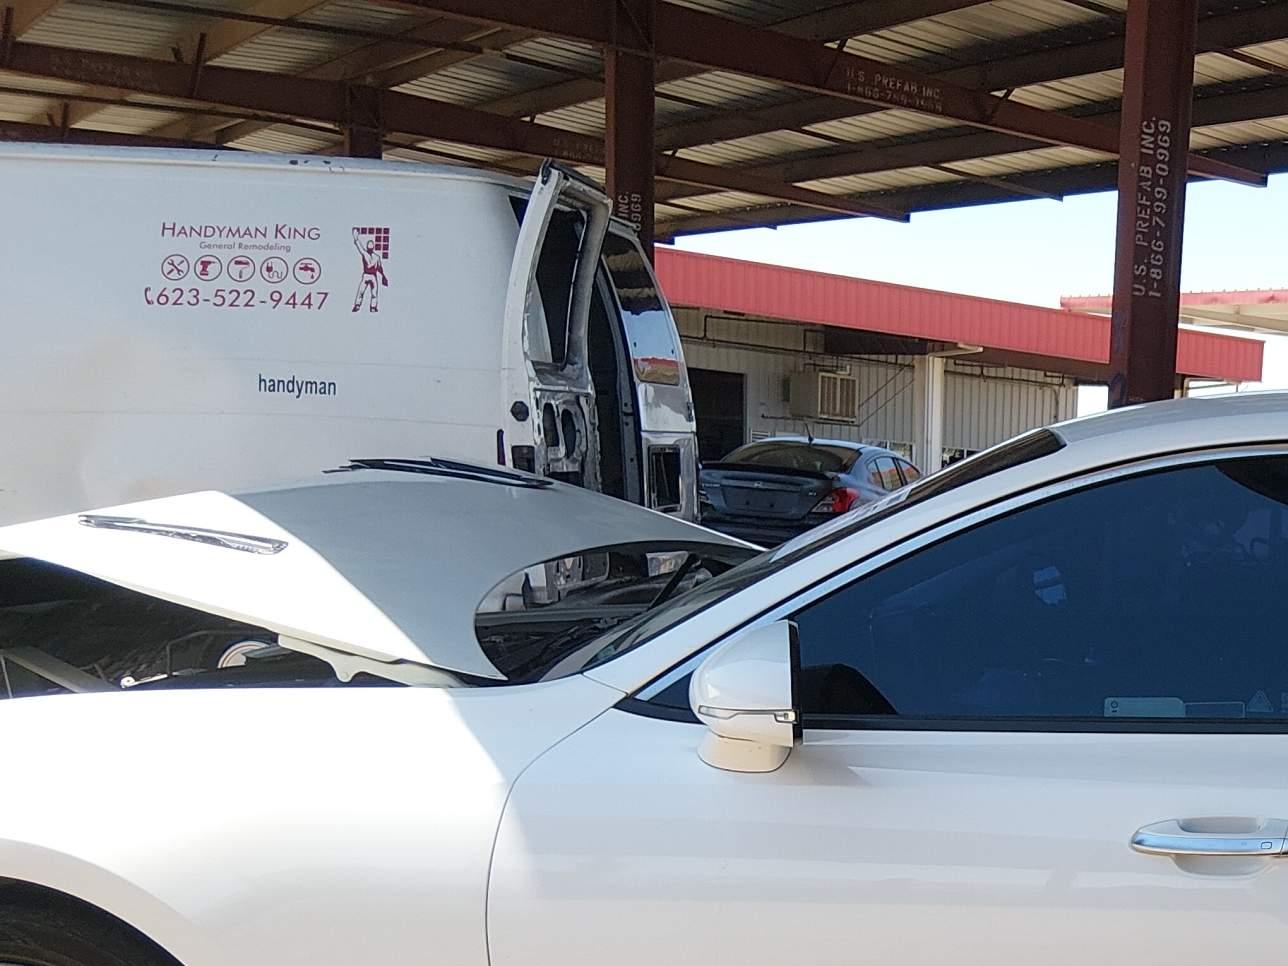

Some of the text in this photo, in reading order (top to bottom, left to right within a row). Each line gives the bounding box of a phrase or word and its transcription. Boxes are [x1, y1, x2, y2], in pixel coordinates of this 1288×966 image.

[1132, 116, 1157, 297] U.S. PREFAB INC.
[1148, 120, 1172, 297] 1-866-799-0969
[161, 222, 321, 241] HANDYMAN KING
[199, 241, 291, 253] General Remodeling
[156, 287, 329, 310] 623-522-9447
[258, 373, 337, 399] handyman
